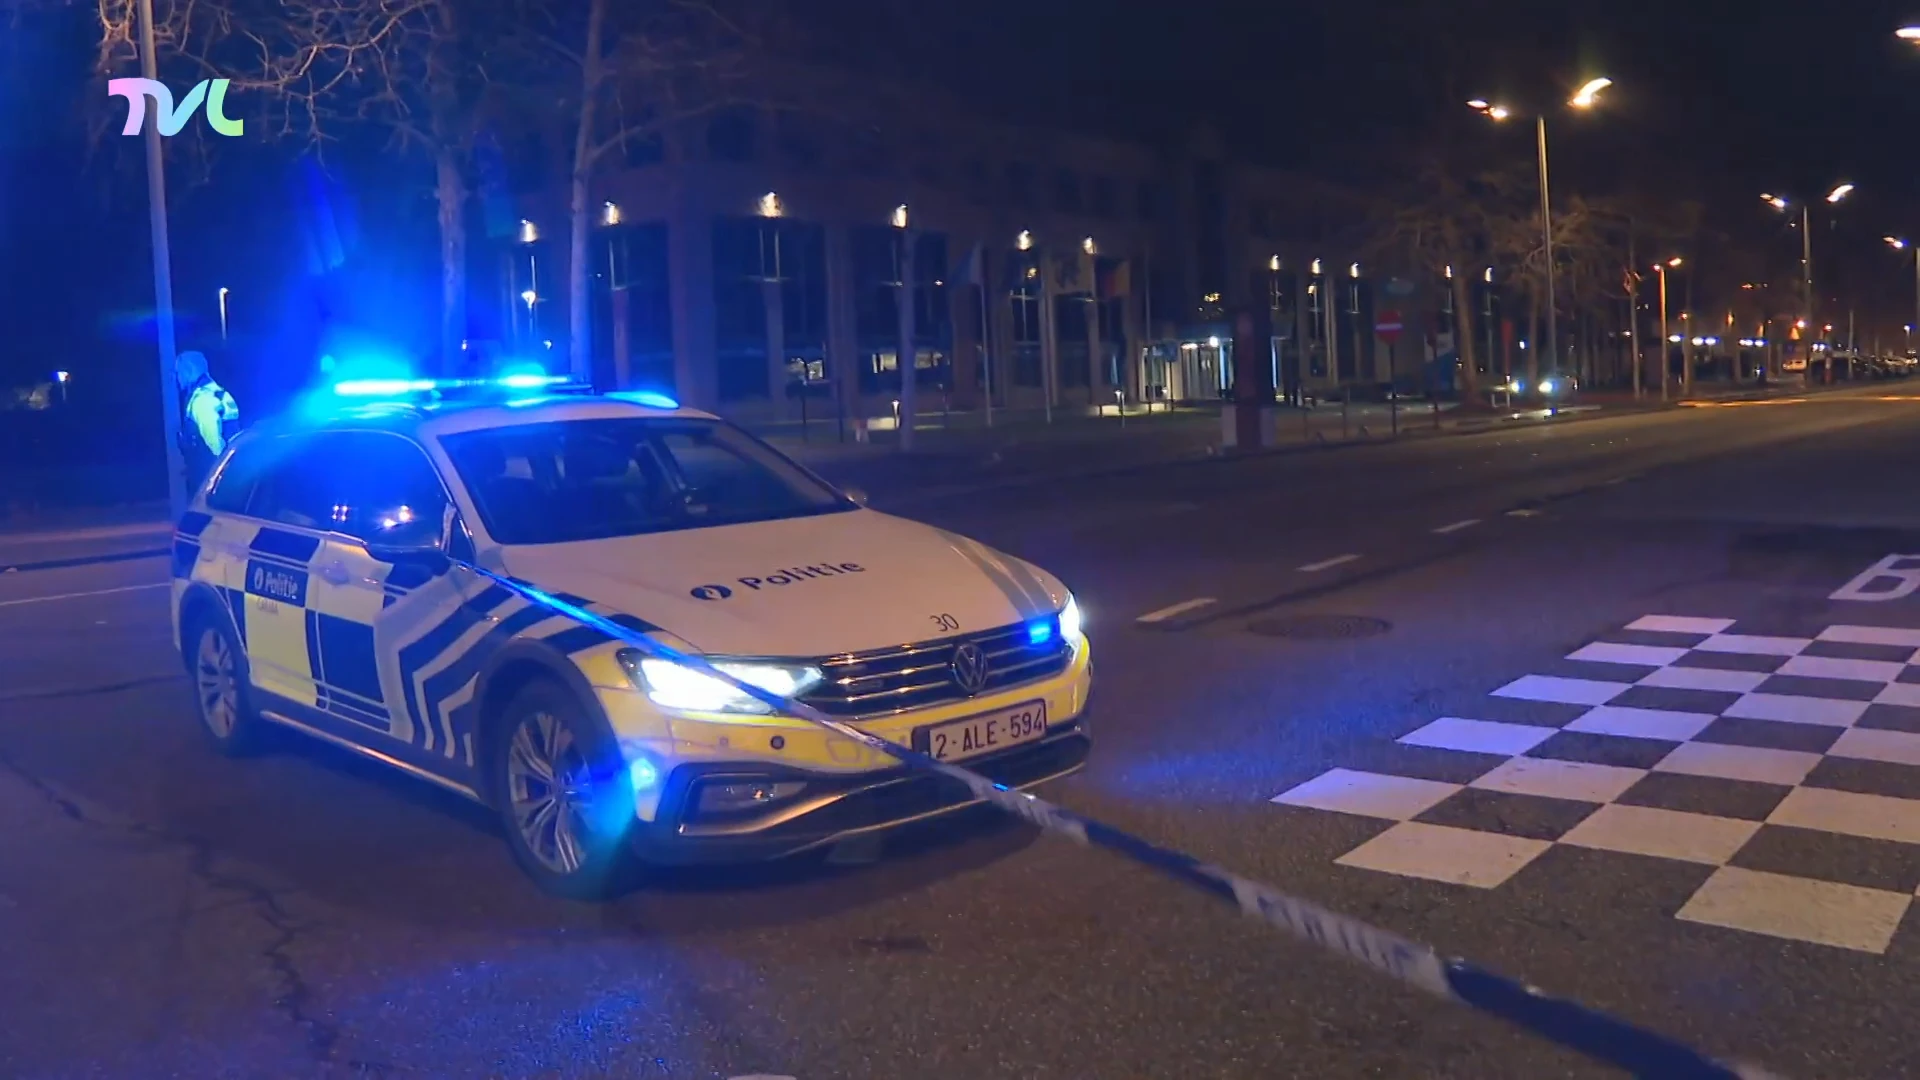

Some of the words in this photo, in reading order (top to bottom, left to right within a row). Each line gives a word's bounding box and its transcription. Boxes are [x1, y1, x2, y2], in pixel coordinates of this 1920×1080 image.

[264, 571, 299, 600] Politie
[738, 562, 866, 590] Politie
[929, 613, 960, 632] 30
[935, 707, 1042, 759] 2-ALE-594
